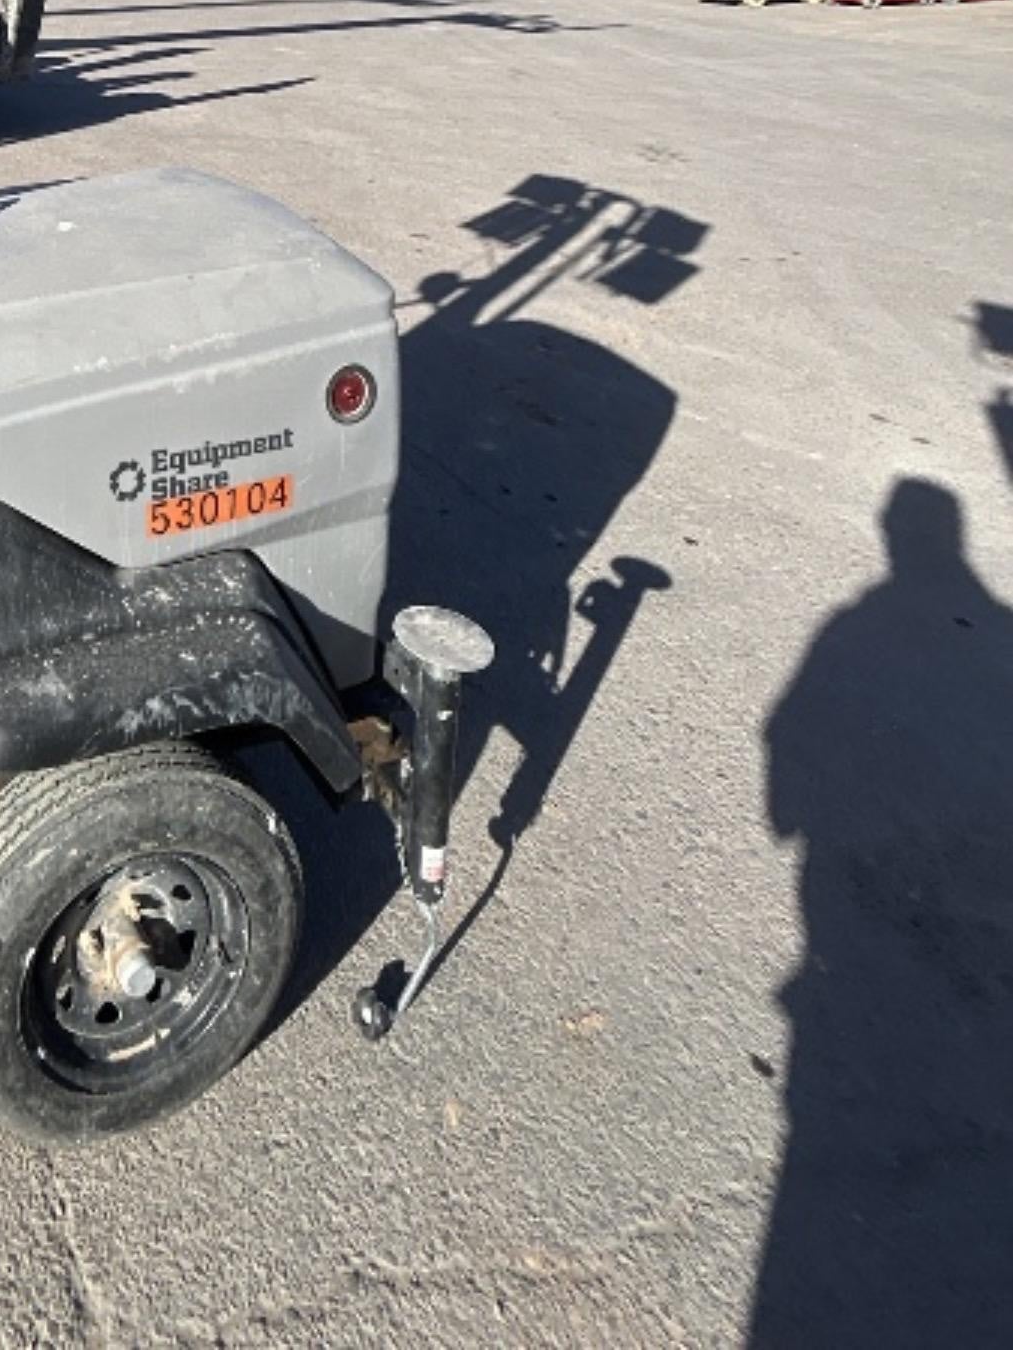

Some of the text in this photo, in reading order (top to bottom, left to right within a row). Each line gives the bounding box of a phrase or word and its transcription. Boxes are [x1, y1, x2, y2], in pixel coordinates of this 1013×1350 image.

[150, 428, 294, 474] Equipment
[150, 478, 288, 535] 530104
[151, 470, 229, 501] Share
